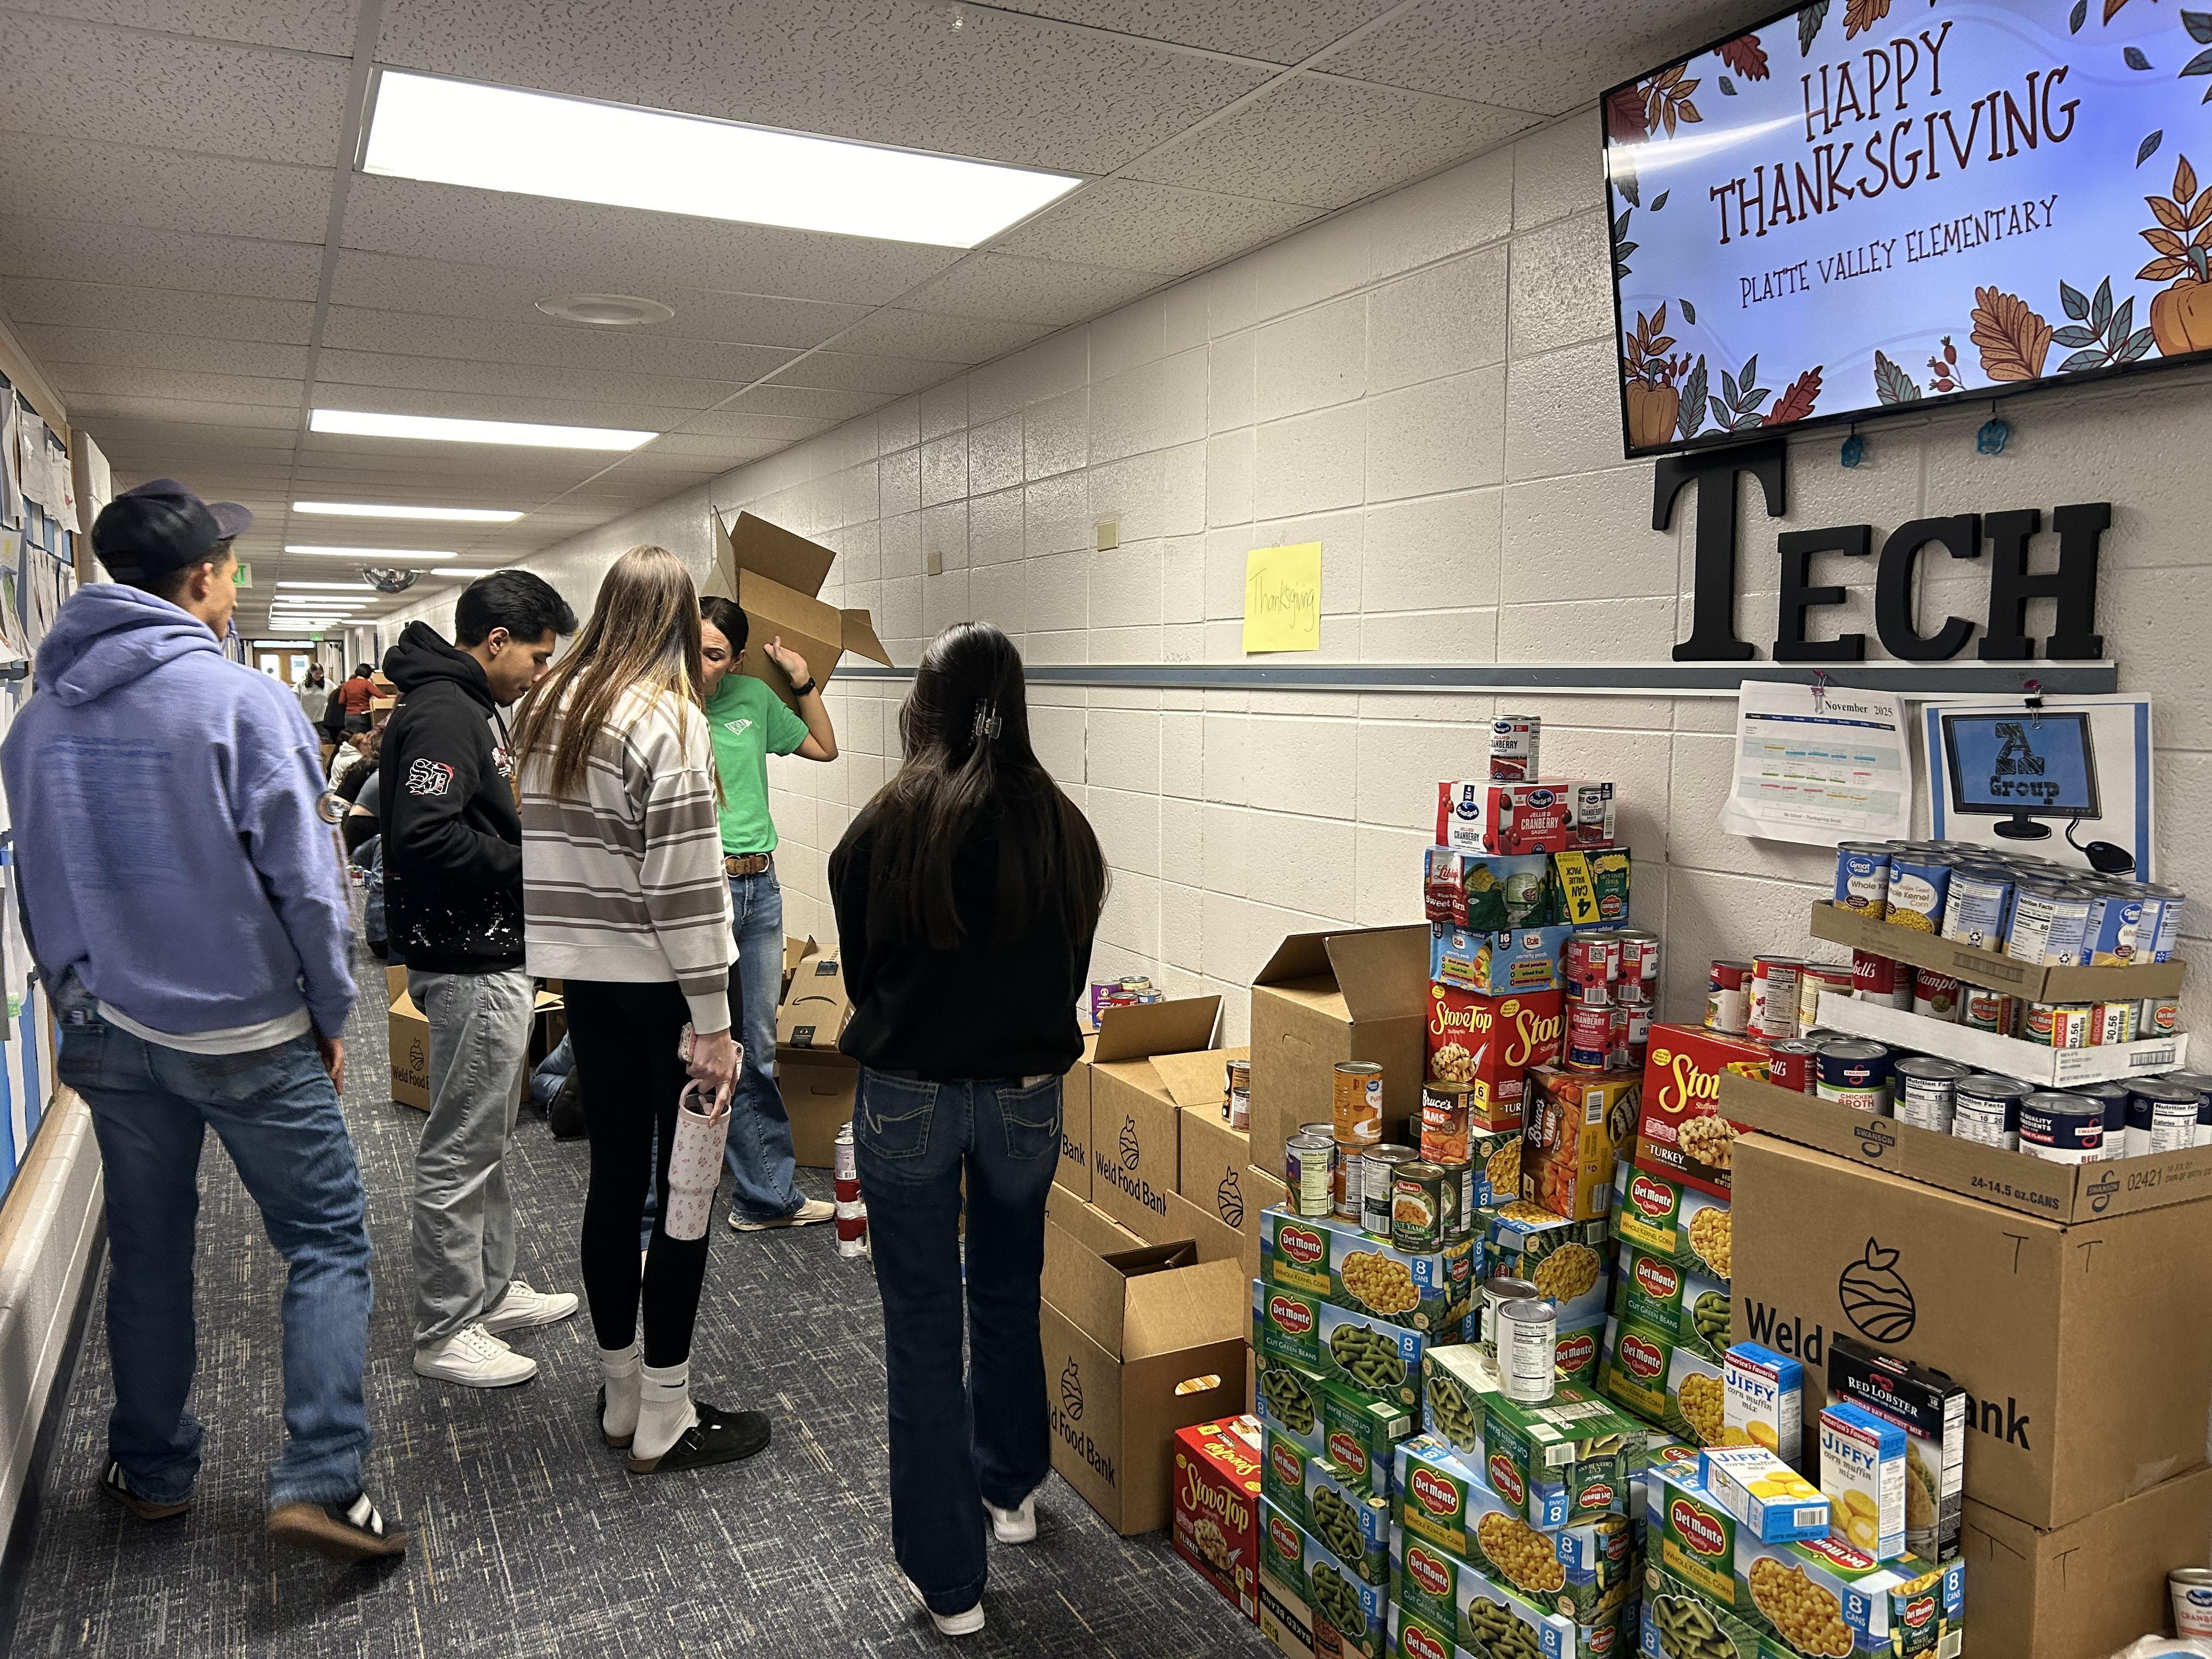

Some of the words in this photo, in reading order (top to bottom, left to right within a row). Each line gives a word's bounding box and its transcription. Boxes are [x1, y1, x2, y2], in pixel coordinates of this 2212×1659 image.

[1801, 21, 1953, 142] HAPPY
[1710, 65, 2080, 244] THANKSGIVING
[1740, 261, 1809, 308] PLATTE
[1818, 239, 1897, 285] VALLEY
[1906, 195, 2058, 264] ELEMENTARY
[1652, 442, 2111, 662] TECH
[1249, 568, 1314, 632] Thanksgiving
[1825, 701, 1867, 713] November
[1874, 705, 1893, 717] 2025
[1995, 723, 2045, 775] A
[1989, 775, 2060, 805] Group
[1521, 817, 1559, 831] CRANBERRY
[1454, 830, 1480, 842] CRANBERRY
[1566, 866, 1581, 875] PACK
[1850, 861, 1870, 870] Great
[1572, 885, 1588, 897] CAN
[1851, 881, 1876, 890] Whole
[1889, 888, 1902, 897] hole
[1904, 891, 1929, 901] Kernel
[1426, 895, 1450, 907] Sweet
[1577, 898, 1591, 917] 4
[2020, 898, 2038, 908] Nutrition
[2038, 902, 2053, 911] Facts
[1500, 934, 1510, 943] 16
[1853, 961, 1875, 978] bell's
[1916, 968, 1958, 990] Campb
[1430, 1001, 1470, 1035] Stove
[1464, 1006, 1492, 1034] Top
[1573, 1014, 1605, 1026] CRANBERRY
[2093, 1008, 2102, 1042] REDUCED
[2107, 1015, 2118, 1040] $0.56
[1505, 1009, 1565, 1066] Stov
[392, 1065, 409, 1084] Weld
[409, 1069, 426, 1088] Food
[1659, 1054, 1720, 1113] Stov
[1423, 1089, 1453, 1110] Bruce's
[1478, 1086, 1483, 1097] 6
[1906, 1091, 1925, 1099] Calories
[1504, 1103, 1521, 1112] TUR
[1695, 1102, 1717, 1111] Stuffing
[1838, 1099, 1874, 1109] BROTH
[1423, 1109, 1445, 1123] YAMS
[1528, 1099, 1545, 1148] Bruce's
[1543, 1110, 1556, 1141] YAMS
[1857, 1128, 1893, 1145] SWANSON
[2032, 1133, 2052, 1141] FLAVOR
[1063, 1133, 1085, 1166] Bank
[1649, 1144, 1684, 1164] TURKEY
[2081, 1154, 2098, 1163] BEEF
[1096, 1150, 1117, 1184] Weld
[1118, 1169, 1141, 1201] Food
[1971, 1176, 2012, 1196] 24-14.5
[2128, 1167, 2163, 1190] 02421
[2089, 1183, 2119, 1194] SWANSON
[1406, 1224, 1425, 1233] YAMS
[1622, 1220, 1640, 1234] WHOLE
[1640, 1227, 1658, 1241] KERNEL
[1658, 1235, 1673, 1247] CORN
[1282, 1233, 1295, 1245] Del
[1296, 1237, 1321, 1254] Monte
[2003, 1232, 2029, 1273] T
[2077, 1240, 2102, 1273] T
[1418, 1261, 1426, 1274] 8
[1414, 1273, 1429, 1284] CANS
[1272, 1305, 1284, 1316] Del
[1285, 1308, 1311, 1324] Monte
[1628, 1300, 1640, 1311] CUT
[1640, 1304, 1658, 1319] GREEN
[1660, 1314, 1678, 1328] BEANS
[1745, 1297, 1824, 1366] Weld
[1404, 1337, 1414, 1351] 8
[1556, 1350, 1568, 1361] Del
[1569, 1345, 1592, 1356] Monte
[1401, 1351, 1416, 1359] CANS
[1725, 1353, 1752, 1370] America's
[1752, 1364, 1776, 1380] Favorite
[1726, 1369, 1775, 1402] JIFFY
[1728, 1386, 1744, 1399] corn
[1744, 1392, 1773, 1412] muffin
[1741, 1401, 1758, 1414] mix
[1848, 1376, 1870, 1393] RED
[1872, 1384, 1919, 1418] LOBSTER
[1930, 1398, 1938, 1407] 10
[1843, 1395, 1871, 1412] CHEDDAR
[1871, 1407, 1882, 1418] BAY
[1884, 1413, 1907, 1430] BISCUIT
[1909, 1426, 1922, 1436] MIX
[1965, 1395, 2031, 1450] ank
[1820, 1414, 1850, 1436] America's
[1850, 1427, 1877, 1447] Favorite
[1048, 1401, 1057, 1432] ld
[1059, 1410, 1085, 1458] Food
[1087, 1436, 1115, 1489] Bank
[1822, 1432, 1876, 1470] JIFFY
[1881, 1438, 1904, 1451] JIFFY
[1716, 1451, 1773, 1464] JIFFY
[1824, 1451, 1841, 1465] corn
[1842, 1460, 1872, 1481] muffin
[1838, 1468, 1857, 1481] mix
[1182, 1463, 1225, 1516] Stove
[1218, 1485, 1249, 1534] Top
[1674, 1507, 1690, 1523] Del
[1691, 1518, 1722, 1545] Monte
[1180, 1531, 1199, 1554] TURKEY
[1665, 1551, 1689, 1570] WHOLE
[1688, 1563, 1714, 1585] KERNEL
[1712, 1578, 1734, 1597] CORN
[2052, 1547, 2080, 1591] T
[1948, 1573, 1959, 1590] 8
[1262, 1590, 1286, 1617] BEANS
[1848, 1594, 1863, 1613] 8
[1946, 1589, 1961, 1600] CANS
[1286, 1614, 1312, 1645] BAKED
[1846, 1611, 1866, 1627] CANS
